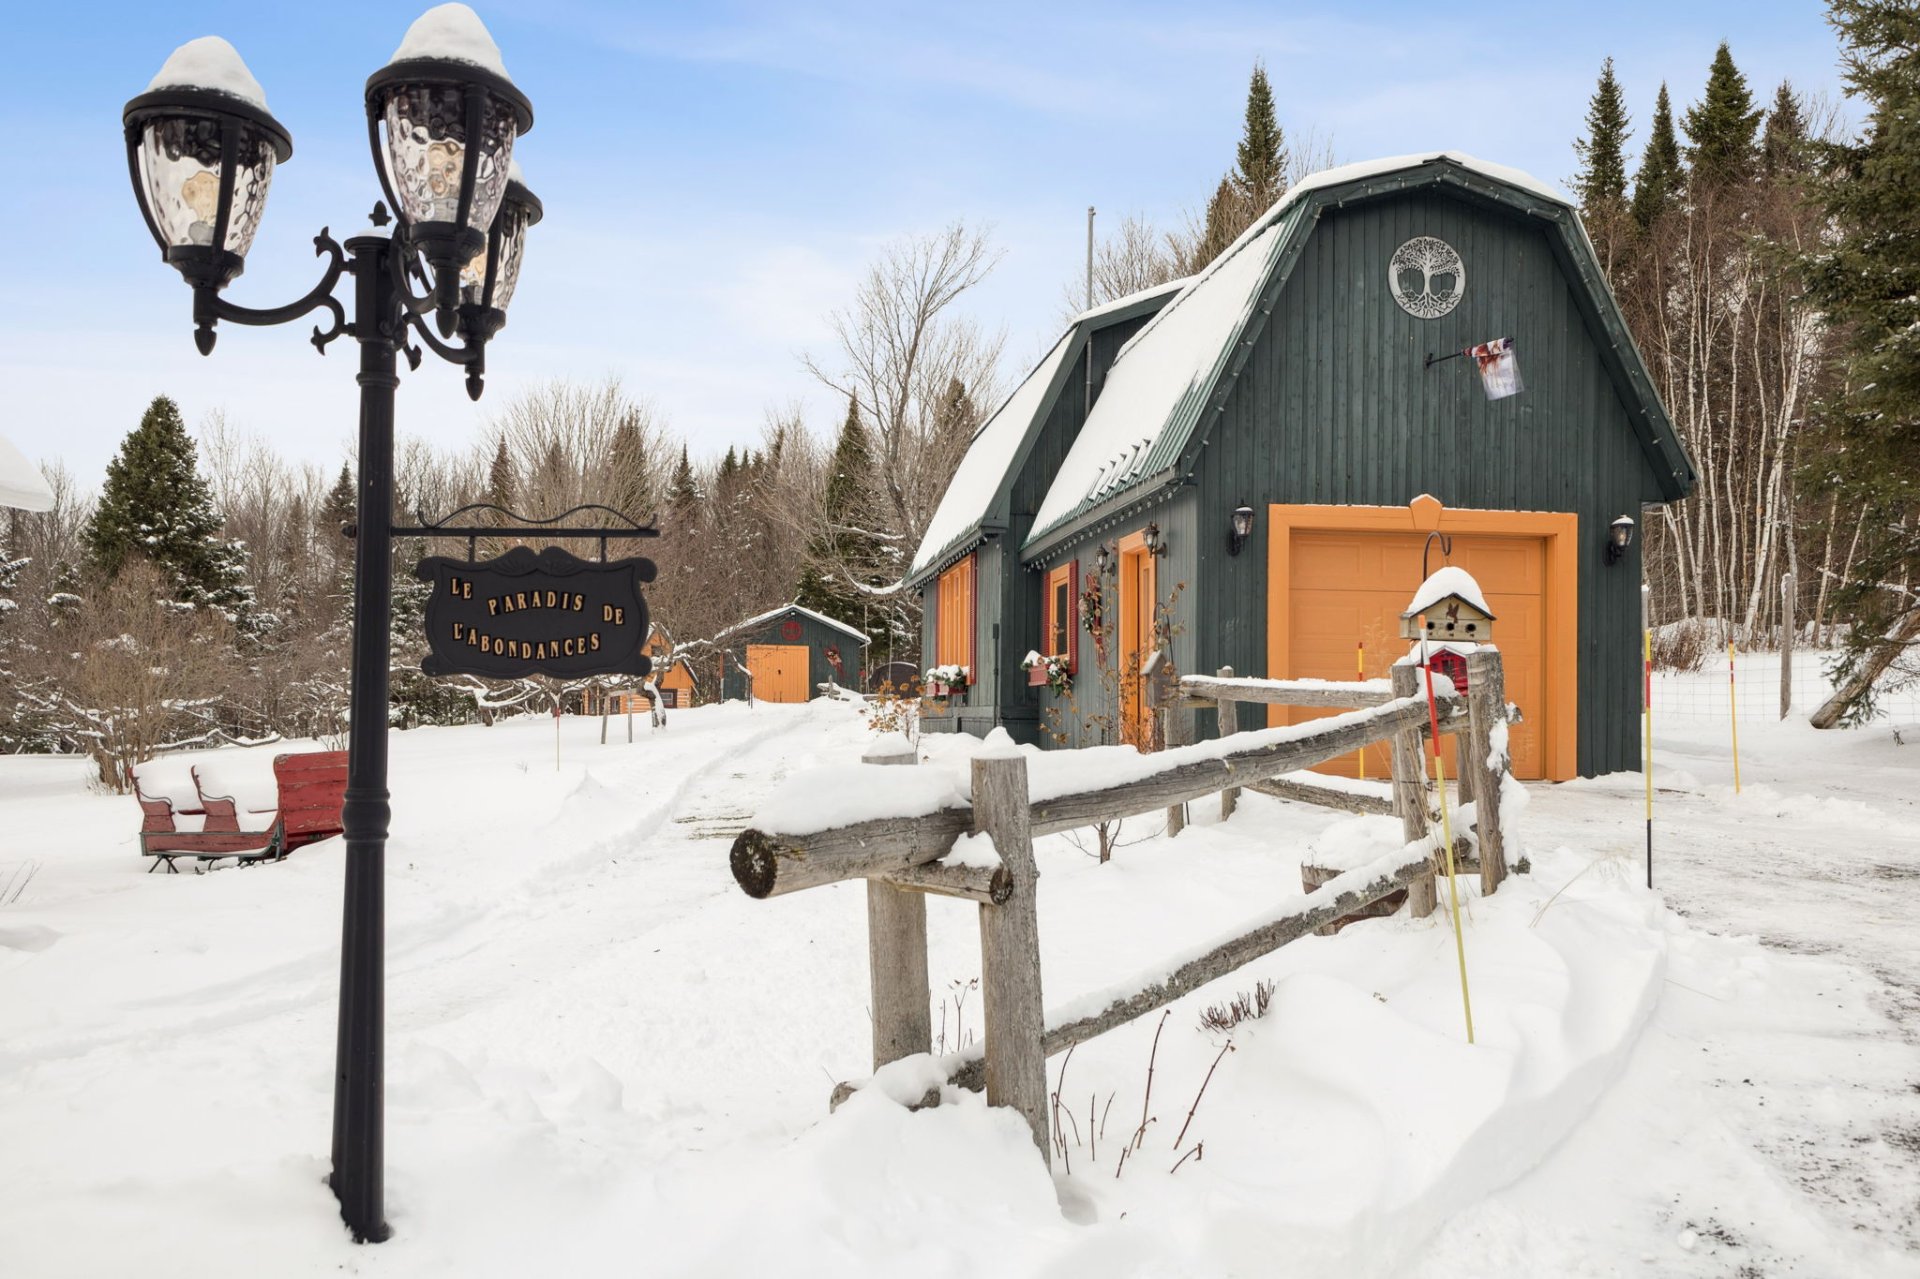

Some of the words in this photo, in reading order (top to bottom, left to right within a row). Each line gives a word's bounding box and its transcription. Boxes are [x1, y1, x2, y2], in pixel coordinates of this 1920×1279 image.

[451, 578, 472, 599] LE
[488, 591, 583, 616] PARADIS
[603, 605, 624, 625] DE
